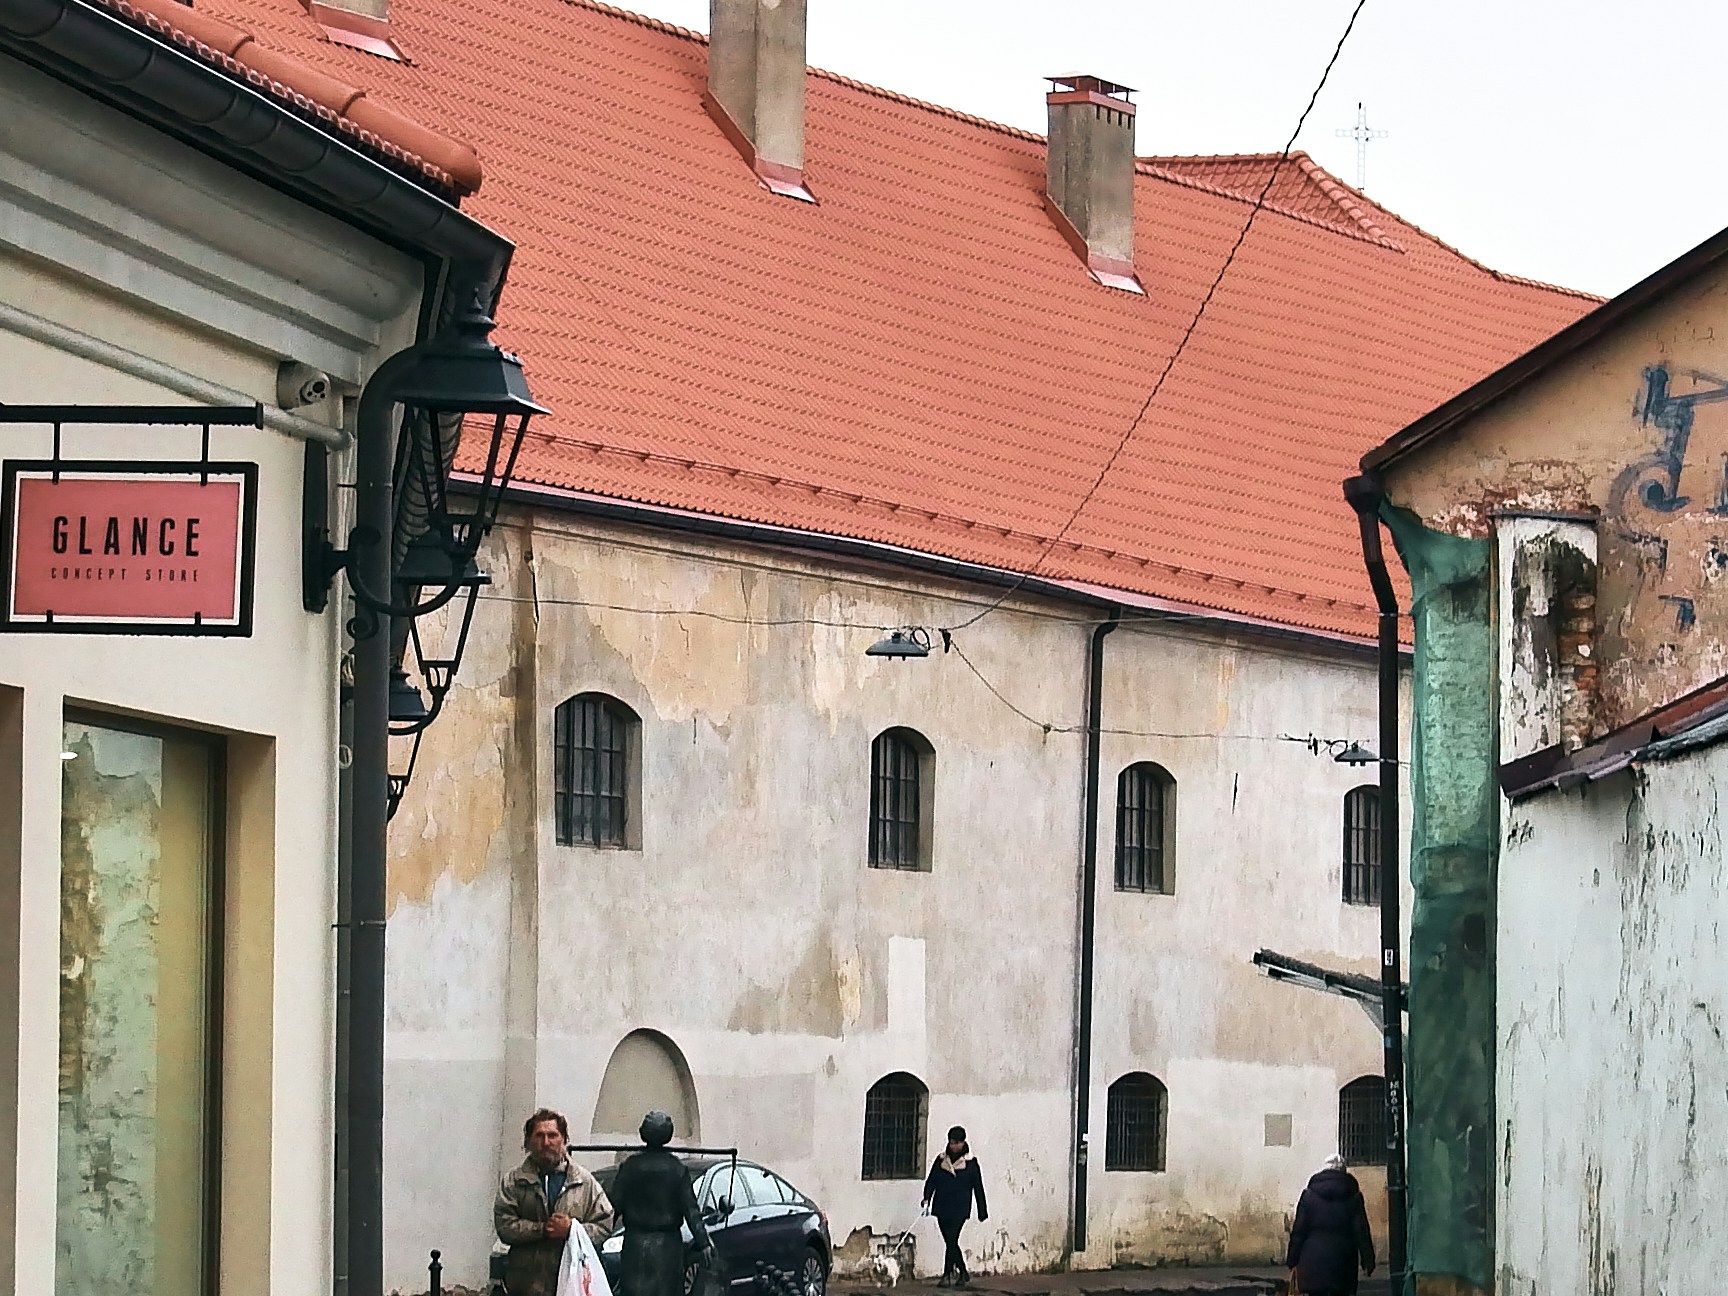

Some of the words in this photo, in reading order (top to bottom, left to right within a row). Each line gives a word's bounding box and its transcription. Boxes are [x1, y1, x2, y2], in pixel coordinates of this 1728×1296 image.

[52, 515, 201, 557] GLANCE
[51, 567, 127, 581] CONCEPT
[144, 568, 198, 582] STORE
